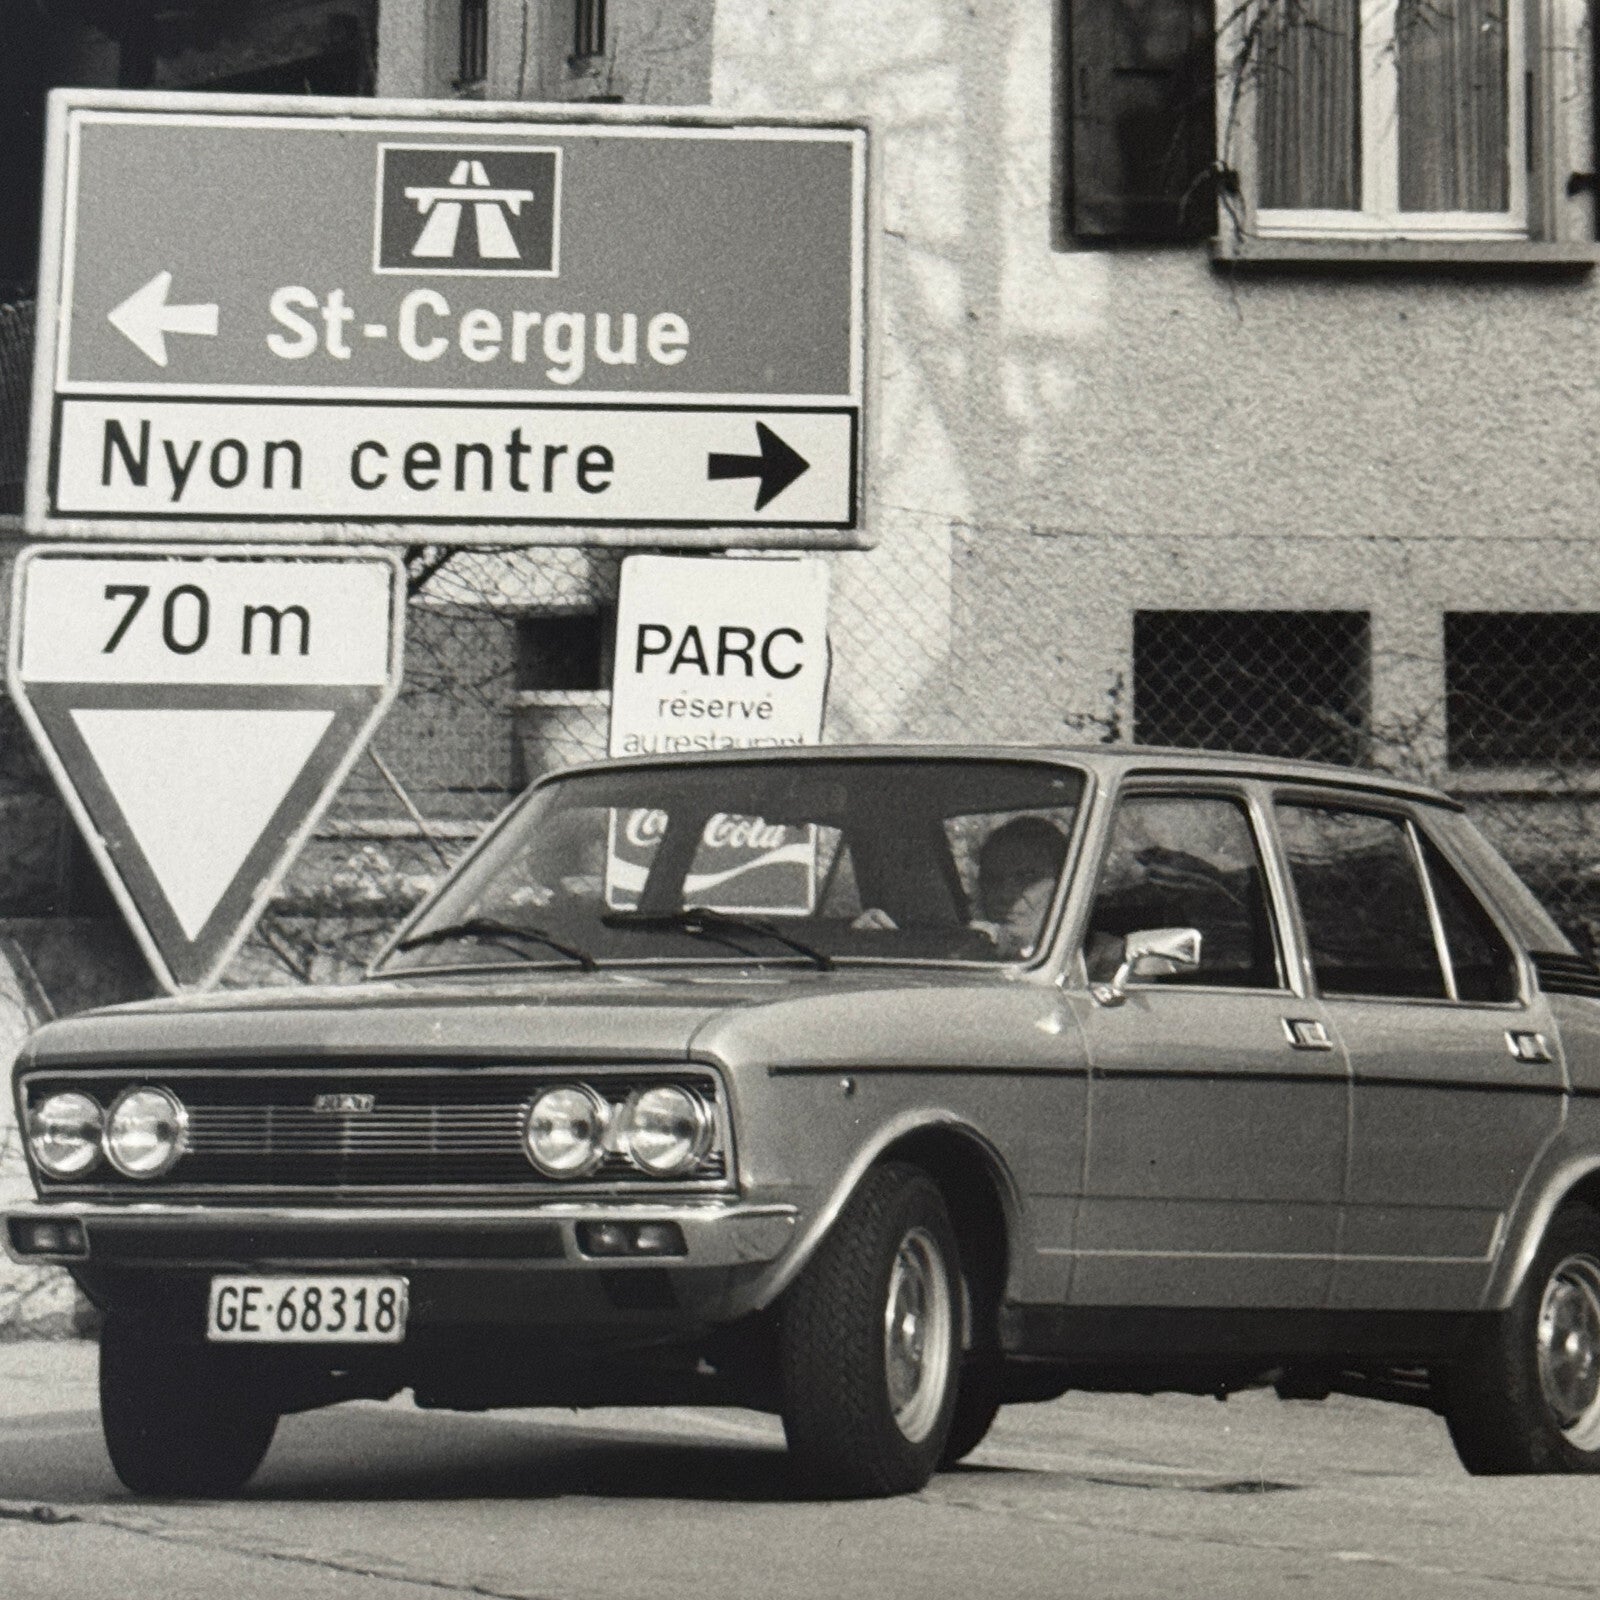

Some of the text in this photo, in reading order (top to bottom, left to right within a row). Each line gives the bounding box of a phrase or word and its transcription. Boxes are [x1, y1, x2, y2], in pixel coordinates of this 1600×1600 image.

[265, 285, 691, 386] St-Cergue
[102, 418, 616, 502] Nyon centre
[103, 584, 311, 656] 70 m
[635, 623, 804, 680] PARC
